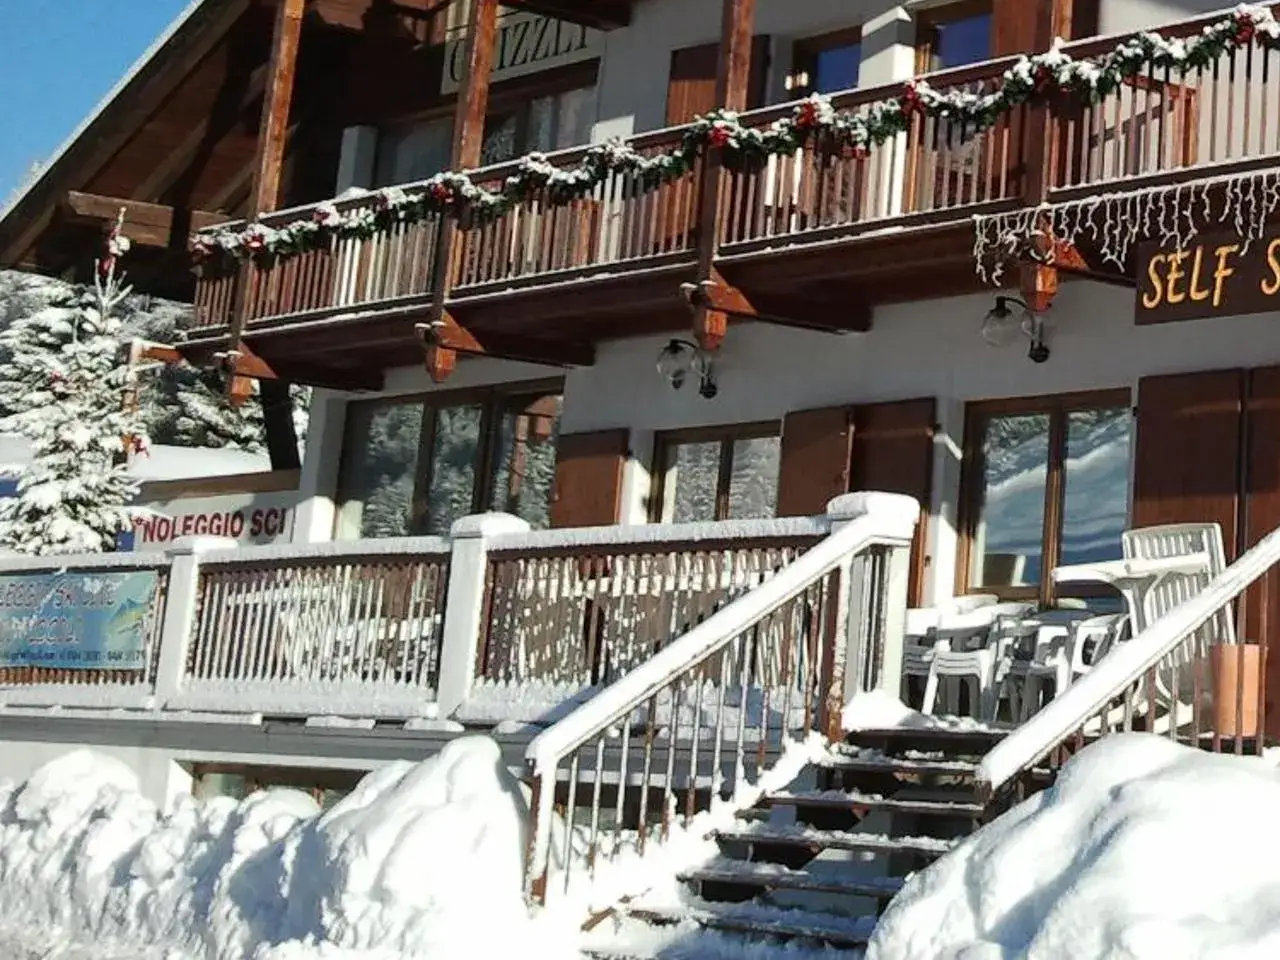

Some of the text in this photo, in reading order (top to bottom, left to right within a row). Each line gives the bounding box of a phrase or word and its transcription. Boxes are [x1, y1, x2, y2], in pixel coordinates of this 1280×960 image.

[1142, 244, 1237, 310] SELF
[143, 507, 287, 542] NOLEGGIO SCI
